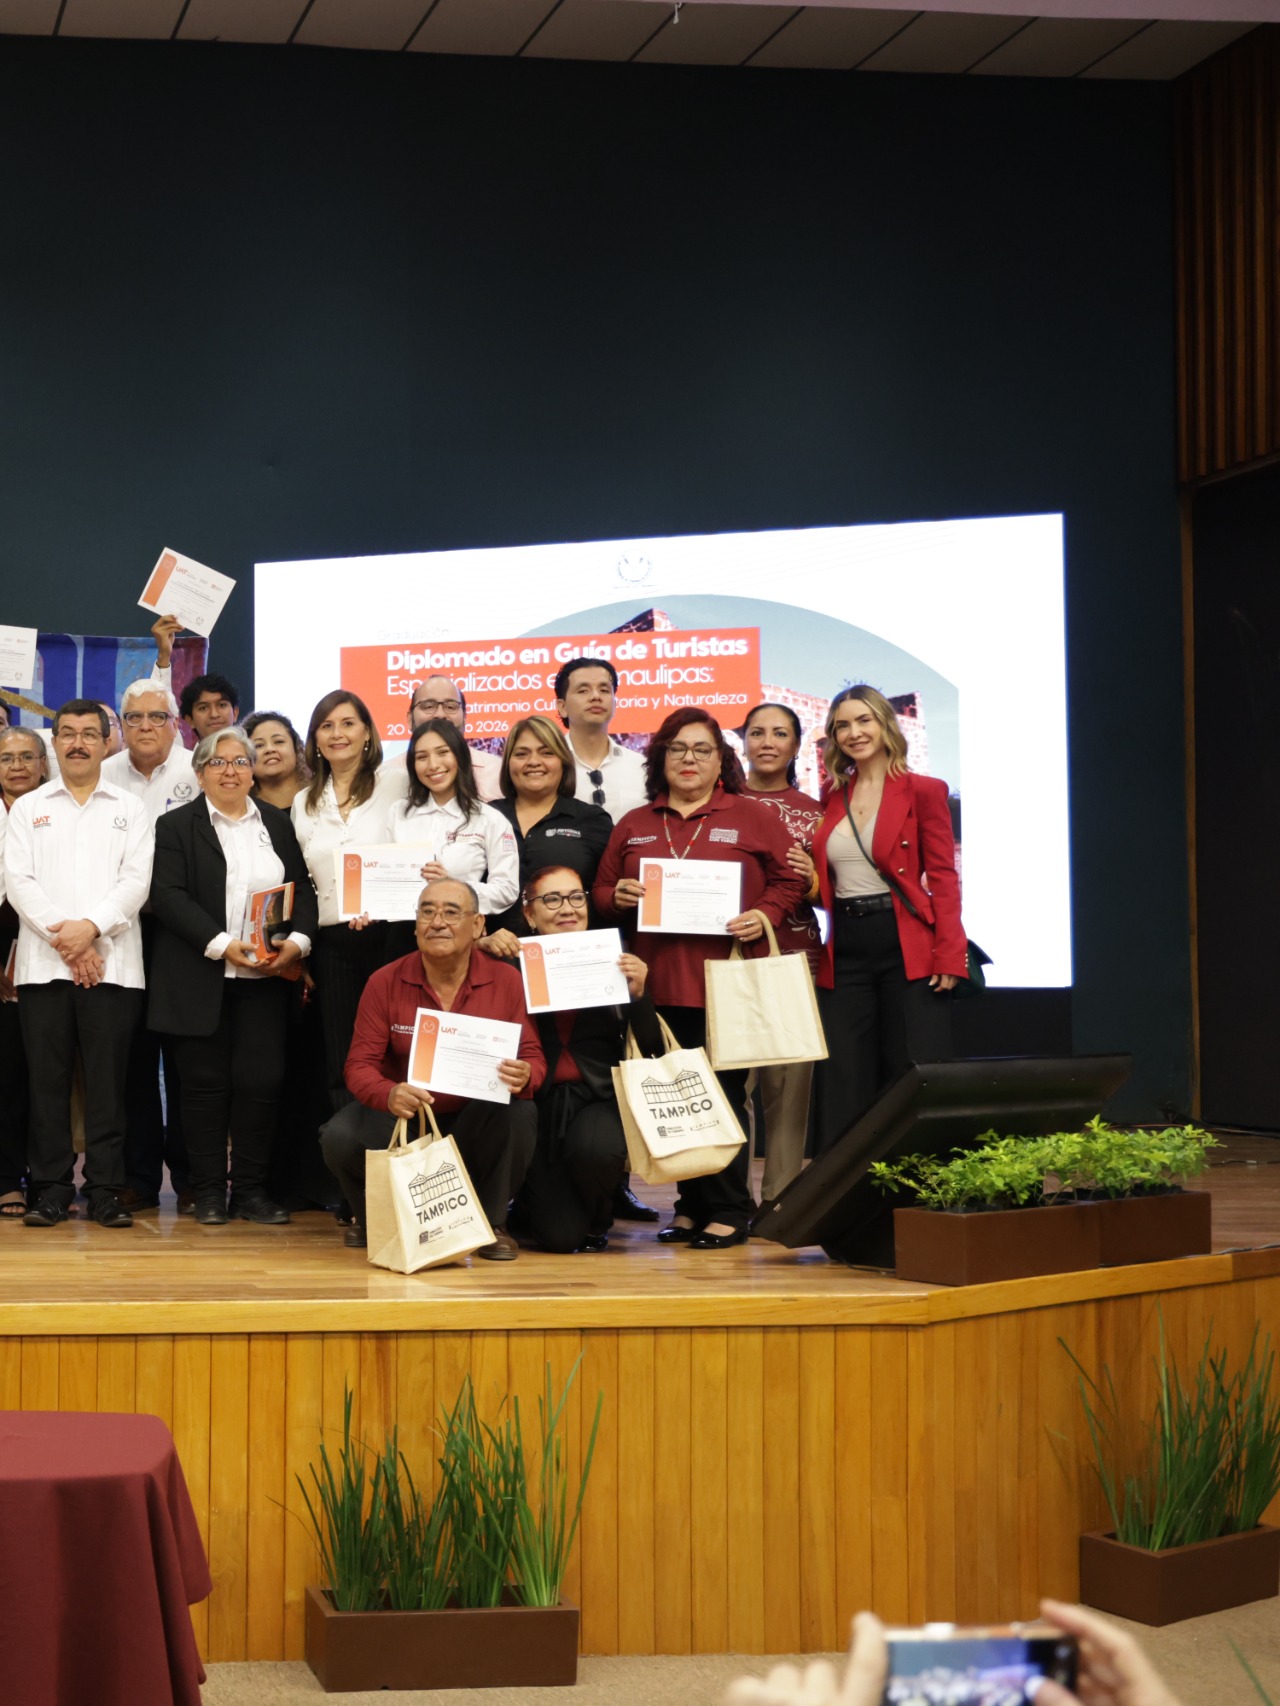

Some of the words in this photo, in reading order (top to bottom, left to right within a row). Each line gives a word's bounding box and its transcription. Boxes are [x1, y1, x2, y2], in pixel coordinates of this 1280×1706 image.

[386, 647, 516, 674] Diplomado
[519, 649, 551, 665] en
[615, 640, 648, 660] de
[652, 636, 748, 658] Turistas
[387, 670, 542, 699] Espializados
[465, 699, 531, 715] atrimonio
[651, 696, 661, 710] y
[663, 692, 748, 707] Naturaleza
[386, 724, 405, 736] 20
[476, 720, 509, 733] 2026
[33, 815, 51, 825] UAT
[664, 871, 681, 879] UAT
[544, 947, 561, 955] UAT
[440, 1026, 458, 1035] UAT
[649, 1098, 713, 1120] TAMPICO
[415, 1193, 468, 1225] TAMPICO
